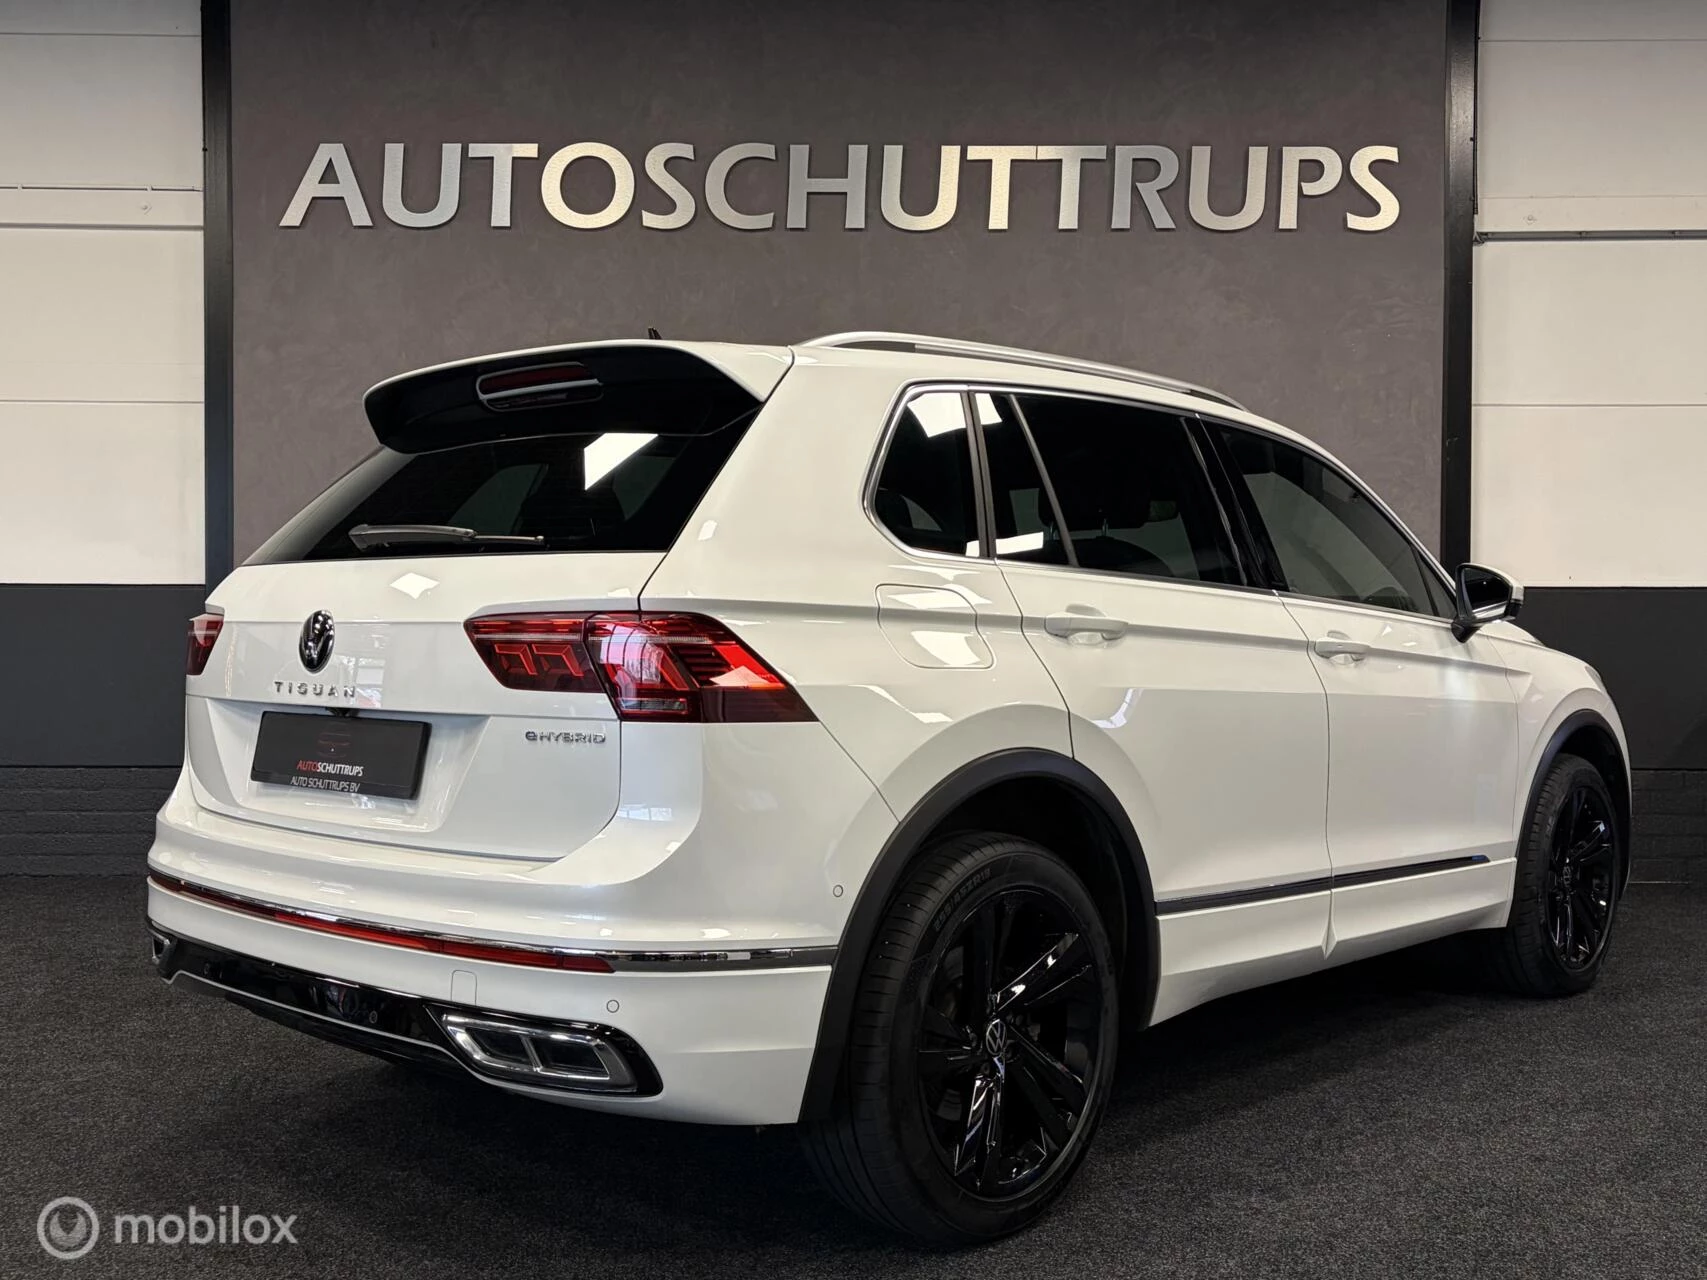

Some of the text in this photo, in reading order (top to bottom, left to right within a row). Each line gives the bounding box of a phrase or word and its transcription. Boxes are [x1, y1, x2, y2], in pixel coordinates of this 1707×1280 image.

[279, 142, 1400, 232] AUTOSCHUTTRUPS
[274, 681, 355, 698] TIGUAN
[297, 760, 364, 777] AUTOSCHUTTRUPS
[290, 776, 360, 793] AUTO SCHUTTRUPS BV
